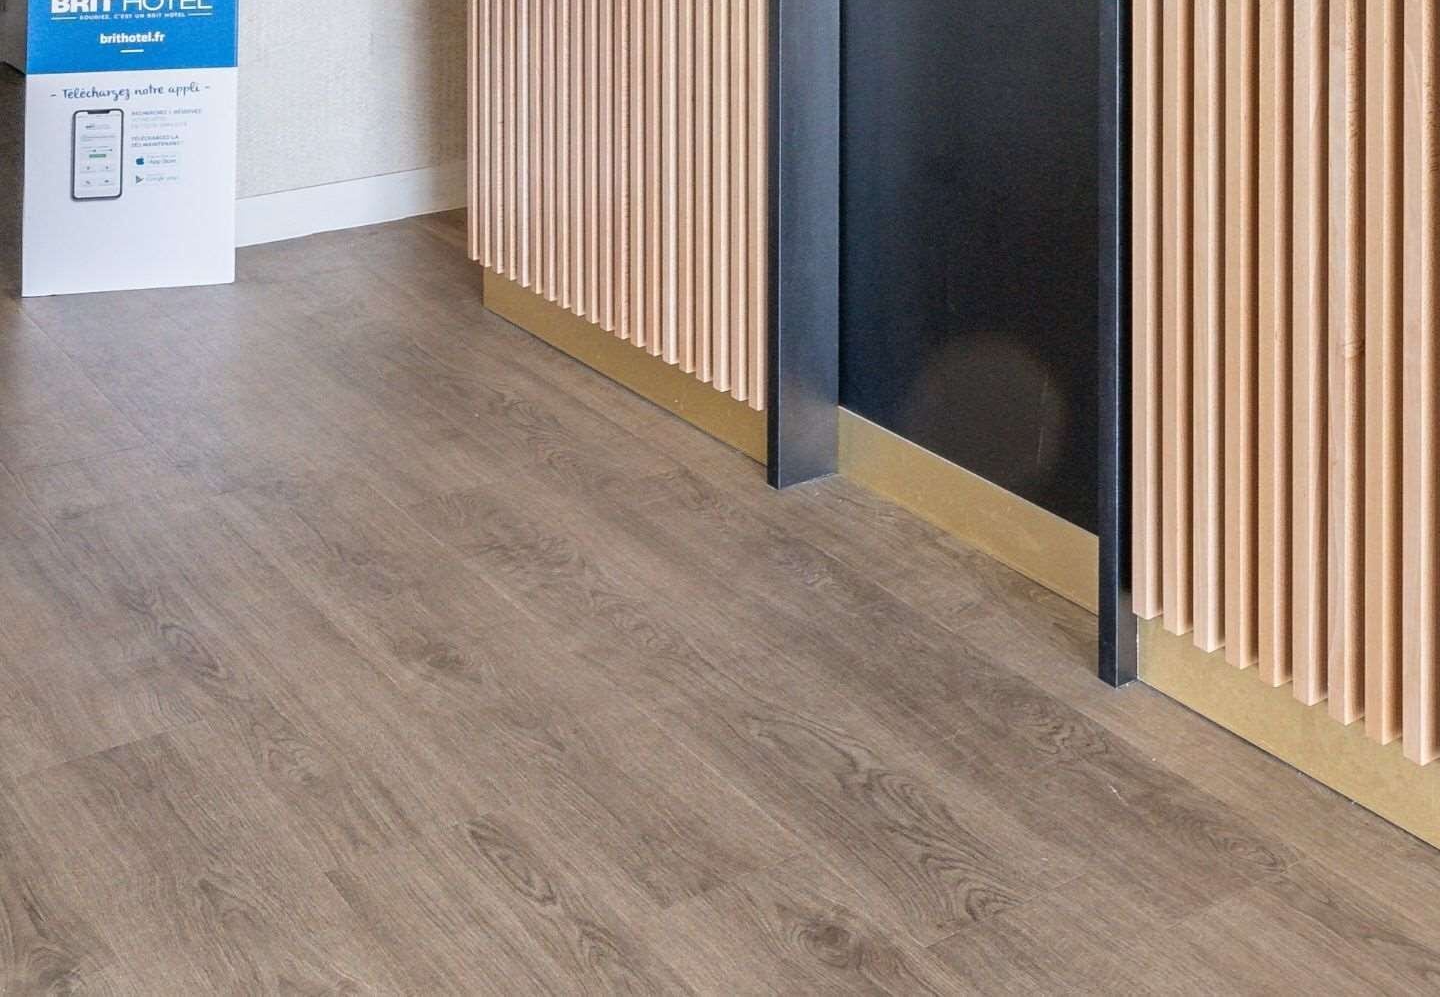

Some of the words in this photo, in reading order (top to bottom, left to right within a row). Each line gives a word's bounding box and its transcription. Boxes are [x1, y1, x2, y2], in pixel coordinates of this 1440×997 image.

[99, 31, 166, 44] brithotel.fr
[134, 84, 164, 96] notre
[168, 82, 200, 97] appli
